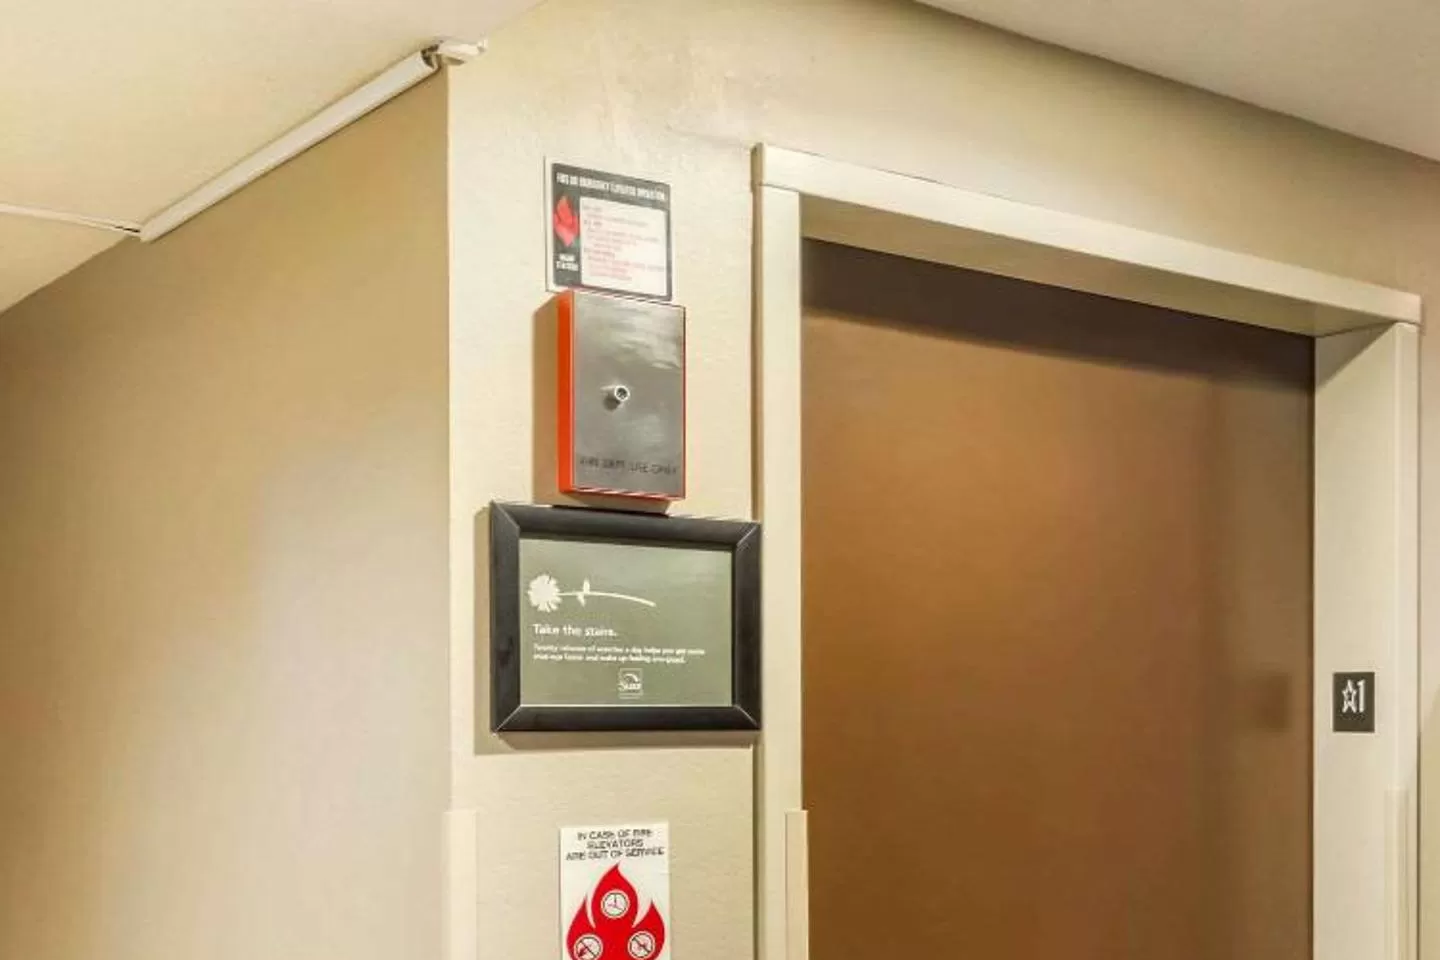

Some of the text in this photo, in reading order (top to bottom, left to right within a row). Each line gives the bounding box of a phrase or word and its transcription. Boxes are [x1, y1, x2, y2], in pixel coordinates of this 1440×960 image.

[533, 622, 560, 635] Take
[562, 624, 582, 637] the
[577, 832, 587, 841] IN
[586, 839, 644, 849] ELEVATORS
